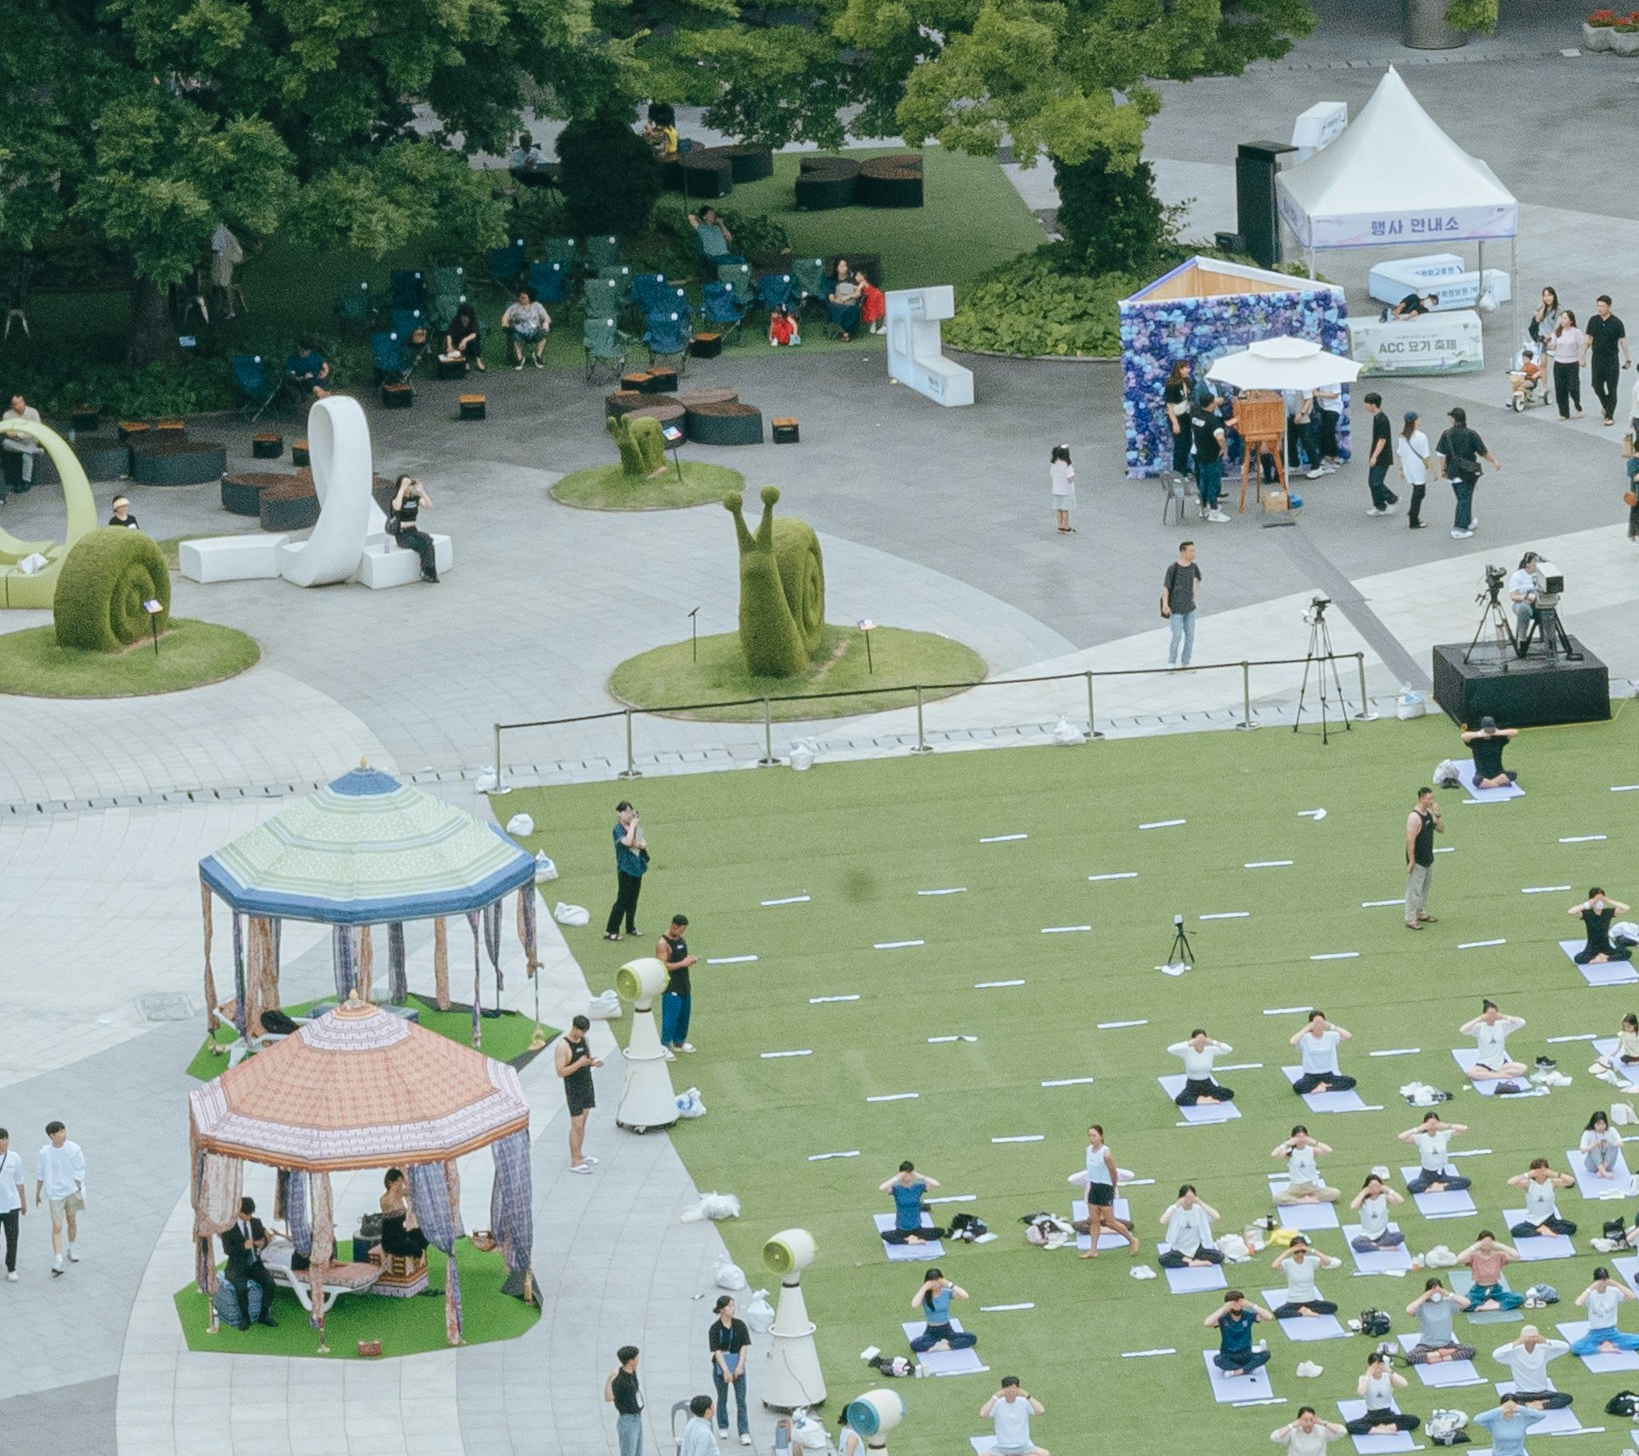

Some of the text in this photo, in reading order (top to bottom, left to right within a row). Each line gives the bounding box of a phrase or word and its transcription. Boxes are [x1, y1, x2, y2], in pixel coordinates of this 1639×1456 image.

[1371, 217, 1459, 237] 행사 안내소
[1378, 339, 1457, 355] ACC 요가 축제
